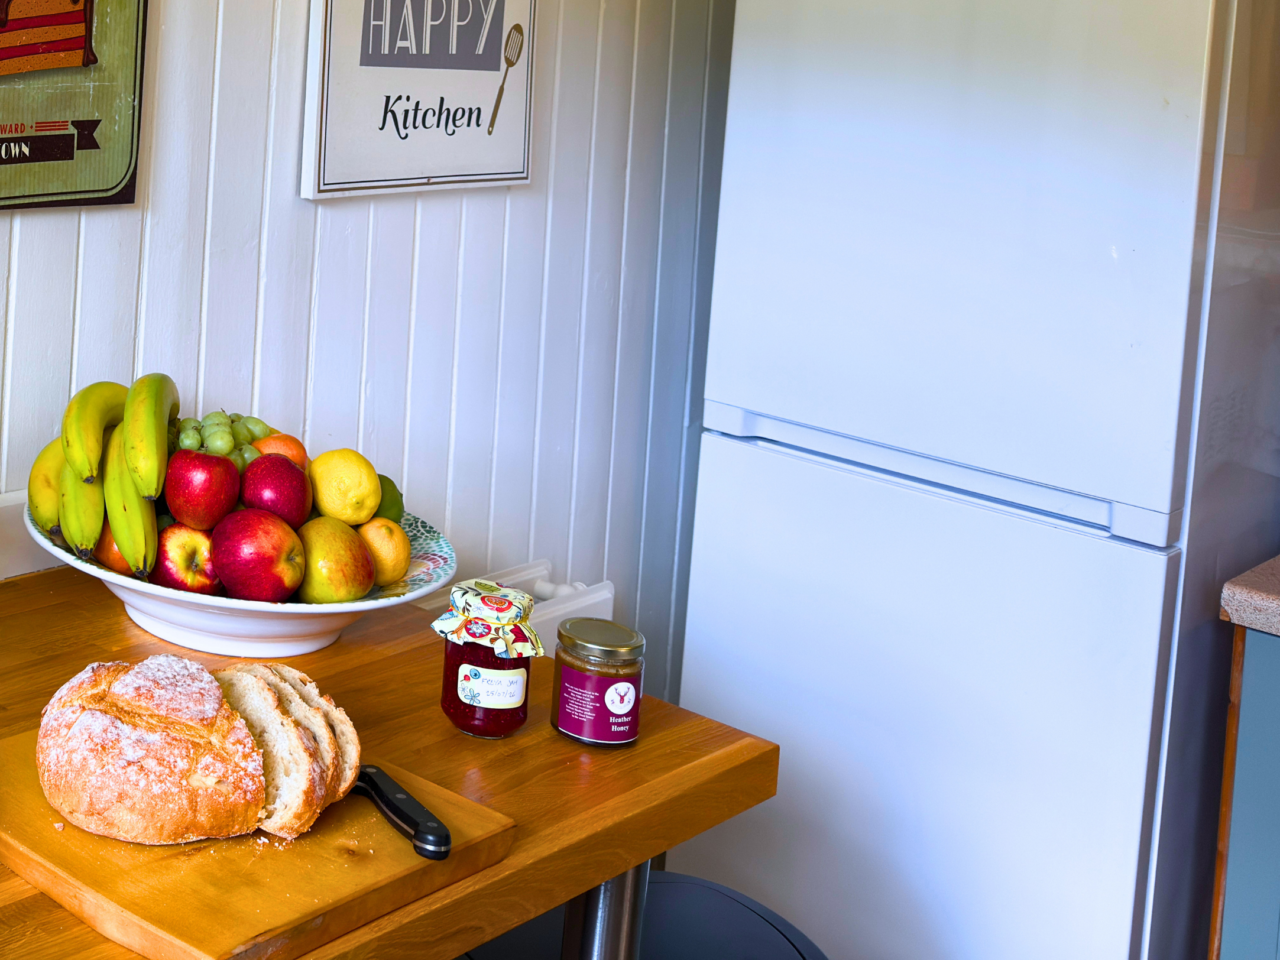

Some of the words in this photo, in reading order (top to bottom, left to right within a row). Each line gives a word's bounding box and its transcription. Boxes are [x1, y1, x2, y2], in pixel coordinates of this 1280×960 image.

[377, 93, 483, 141] Kitchen
[609, 715, 632, 724] Heather
[611, 724, 630, 732] Honey
